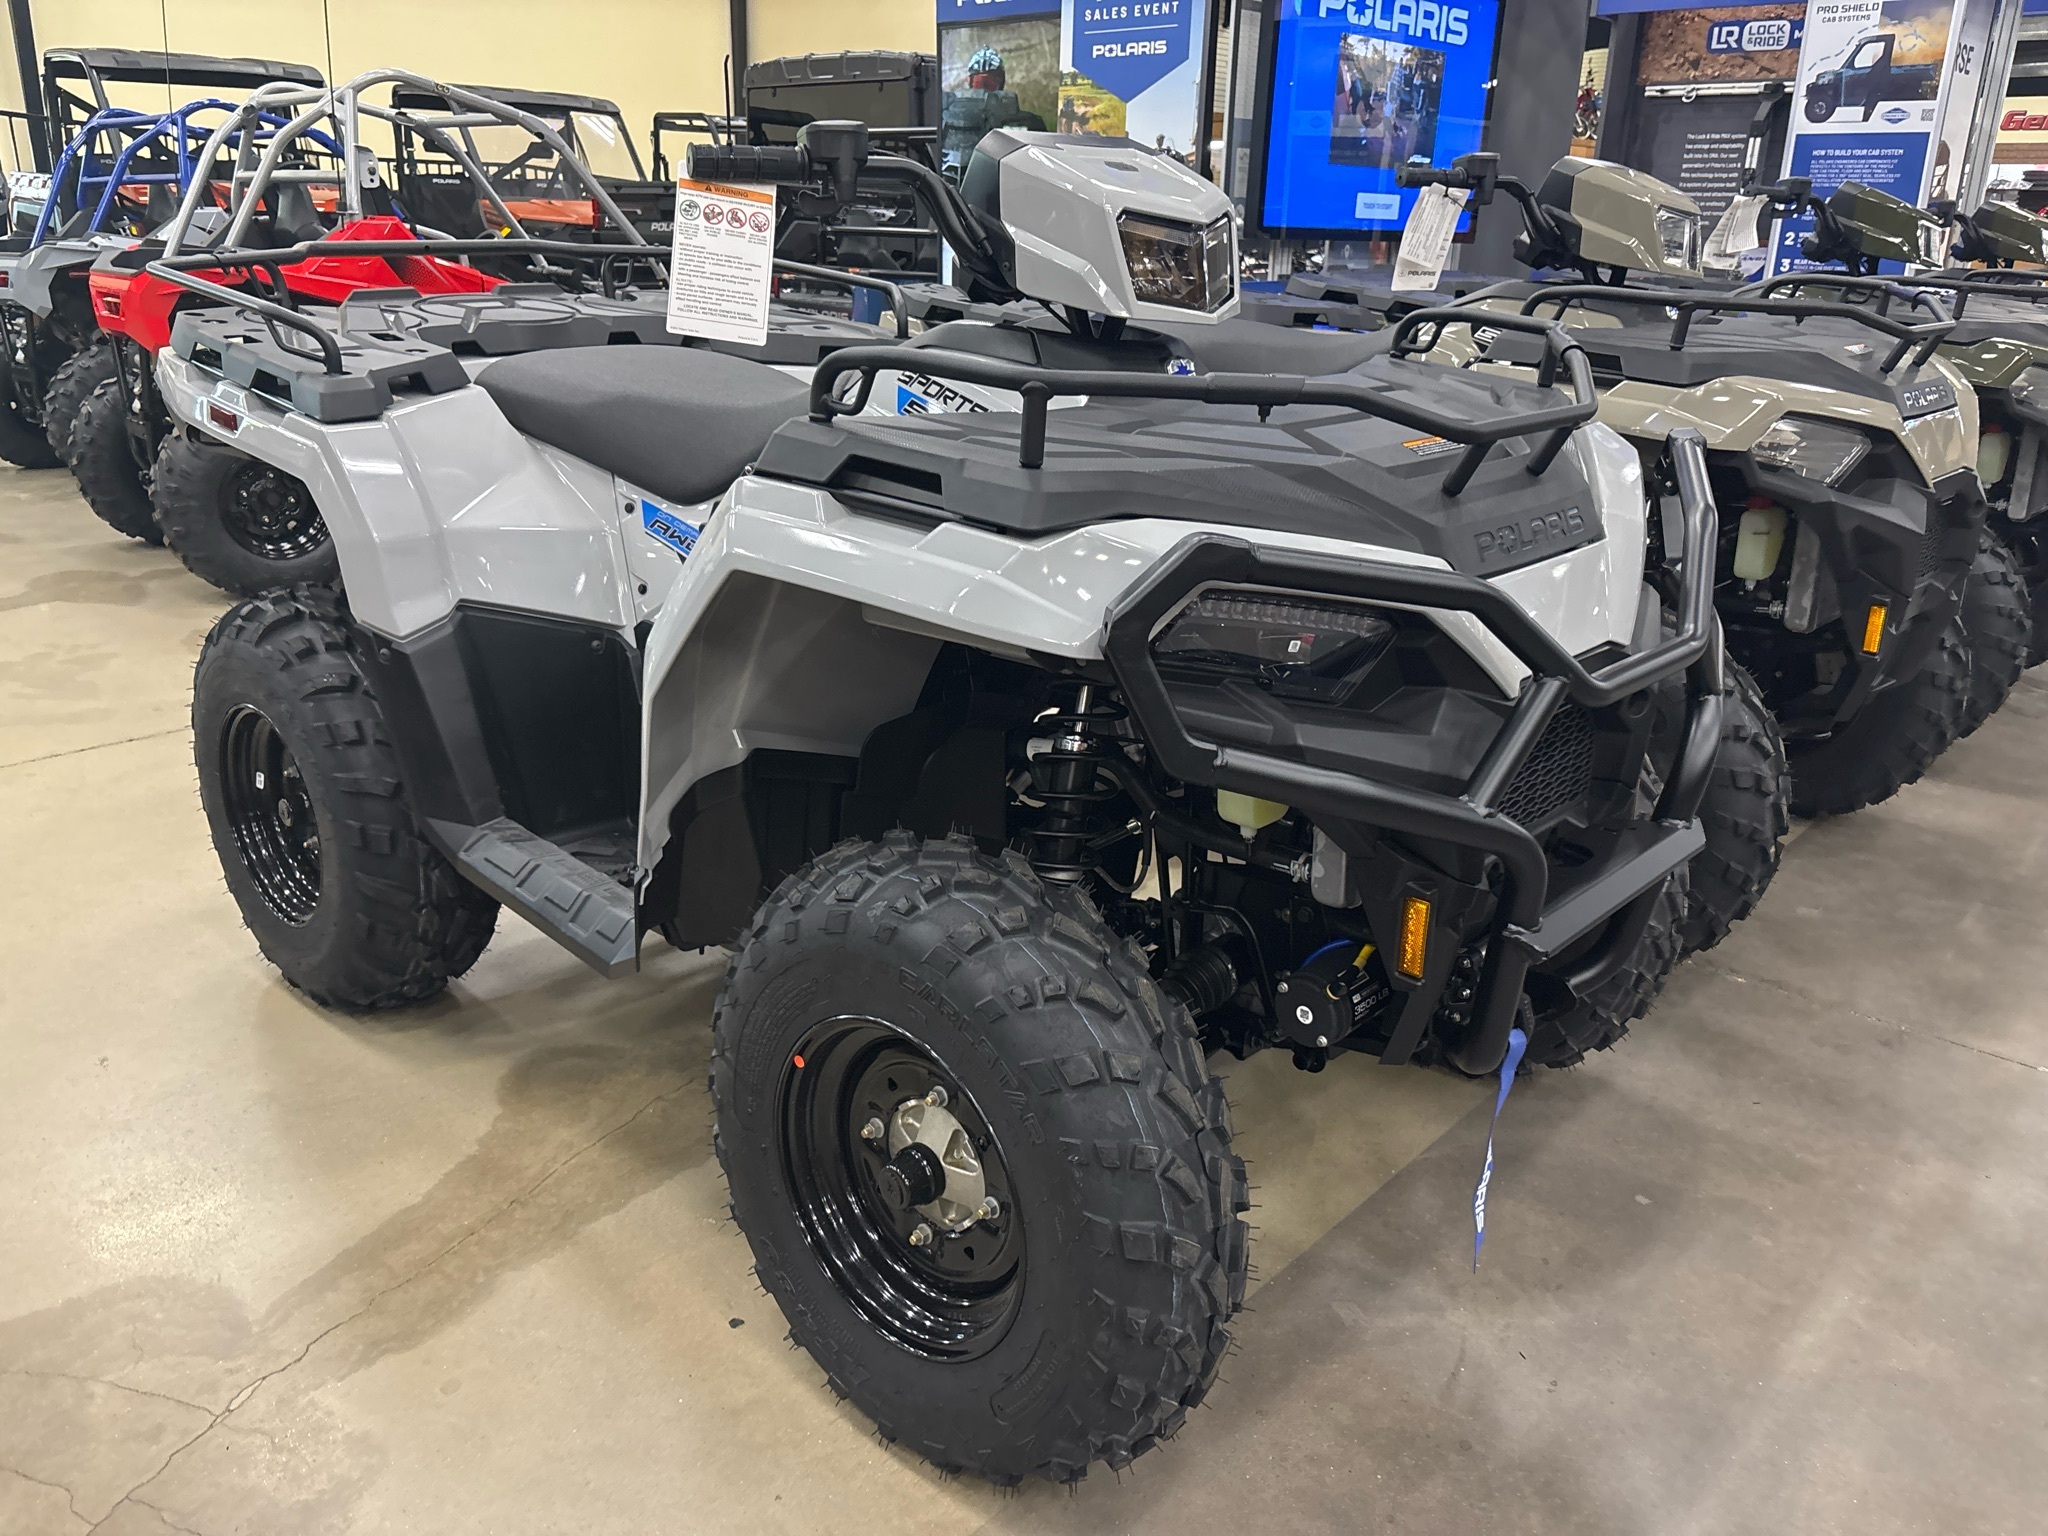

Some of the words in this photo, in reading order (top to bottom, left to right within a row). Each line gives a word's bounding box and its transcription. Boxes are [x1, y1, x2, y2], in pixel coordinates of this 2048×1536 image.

[1085, 6, 1127, 22] SALES
[1135, 1, 1179, 17] EVENT
[1817, 5, 1838, 14] PRO
[1841, 3, 1879, 13] SHIELD
[1319, 0, 1469, 45] POLARIS
[1749, 23, 1785, 36] LOCK
[1711, 26, 1739, 49] LR
[1093, 40, 1167, 58] POLARIS
[714, 187, 748, 198] WARNING
[1785, 232, 1795, 245] 2
[1780, 259, 1791, 272] 3
[657, 511, 672, 521] ON
[1473, 506, 1584, 563] POLARIS
[1355, 996, 1376, 1015] 3500
